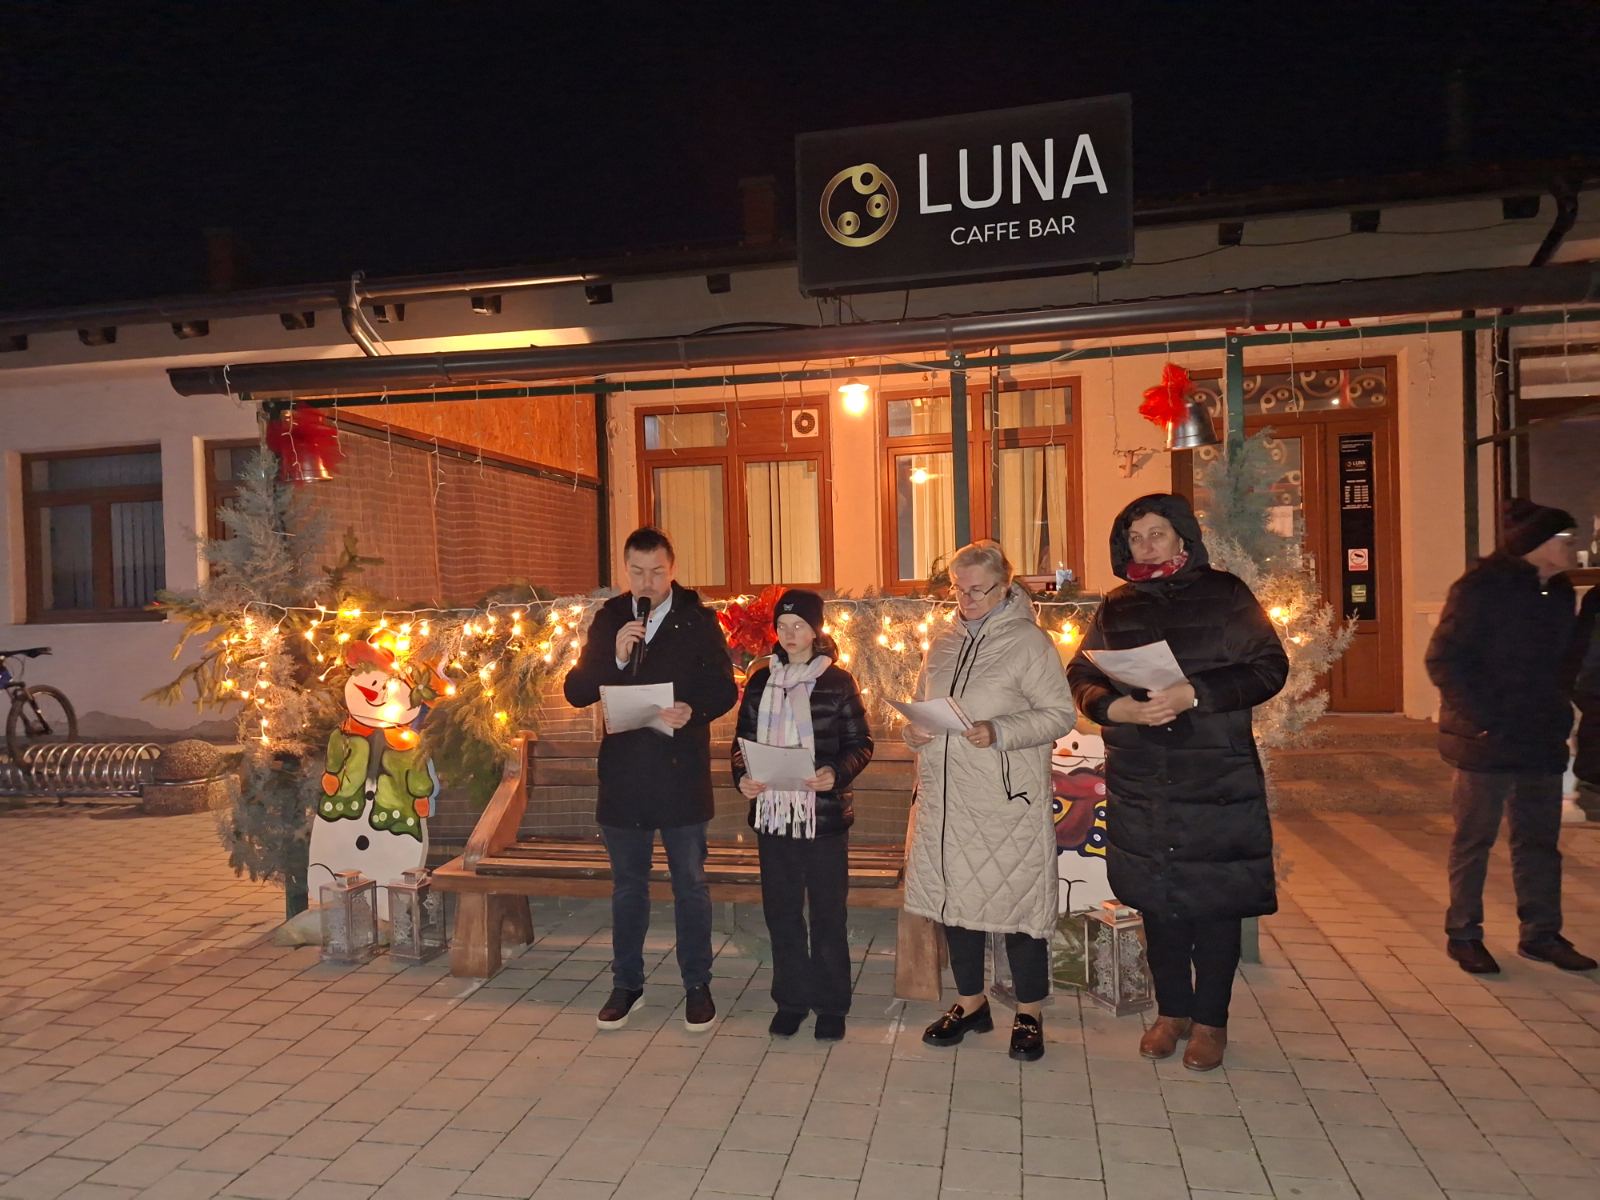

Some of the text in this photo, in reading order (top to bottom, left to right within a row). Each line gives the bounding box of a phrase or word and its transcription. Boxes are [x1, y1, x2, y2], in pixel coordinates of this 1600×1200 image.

[919, 133, 1108, 215] LUNA
[950, 215, 1076, 245] CAFFE BAR
